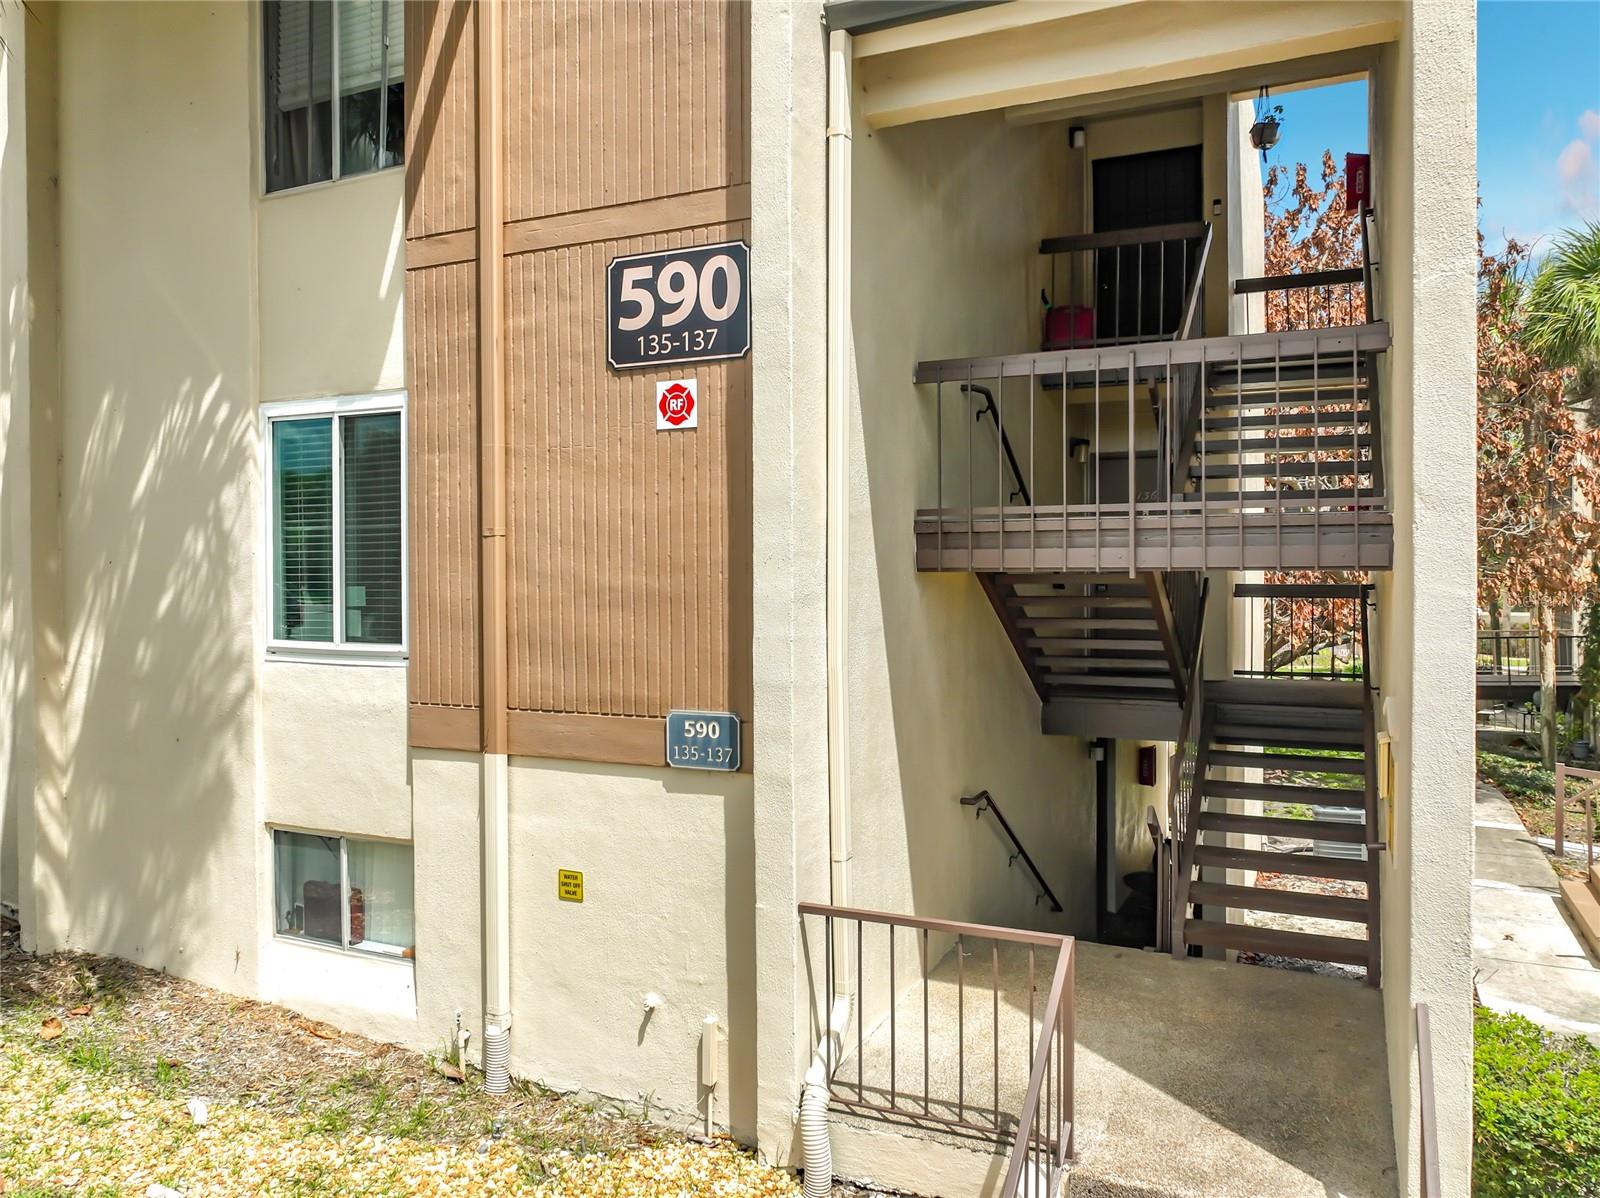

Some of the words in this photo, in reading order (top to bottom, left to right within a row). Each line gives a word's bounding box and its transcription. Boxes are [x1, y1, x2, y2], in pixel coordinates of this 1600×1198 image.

[618, 254, 741, 331] 590
[637, 328, 718, 356] 135-137
[669, 398, 684, 411] RF
[684, 719, 720, 739] 590
[673, 744, 733, 763] 135-137
[561, 881, 572, 889] SHUT
[563, 873, 579, 881] WATER
[564, 889, 577, 897] VALVE
